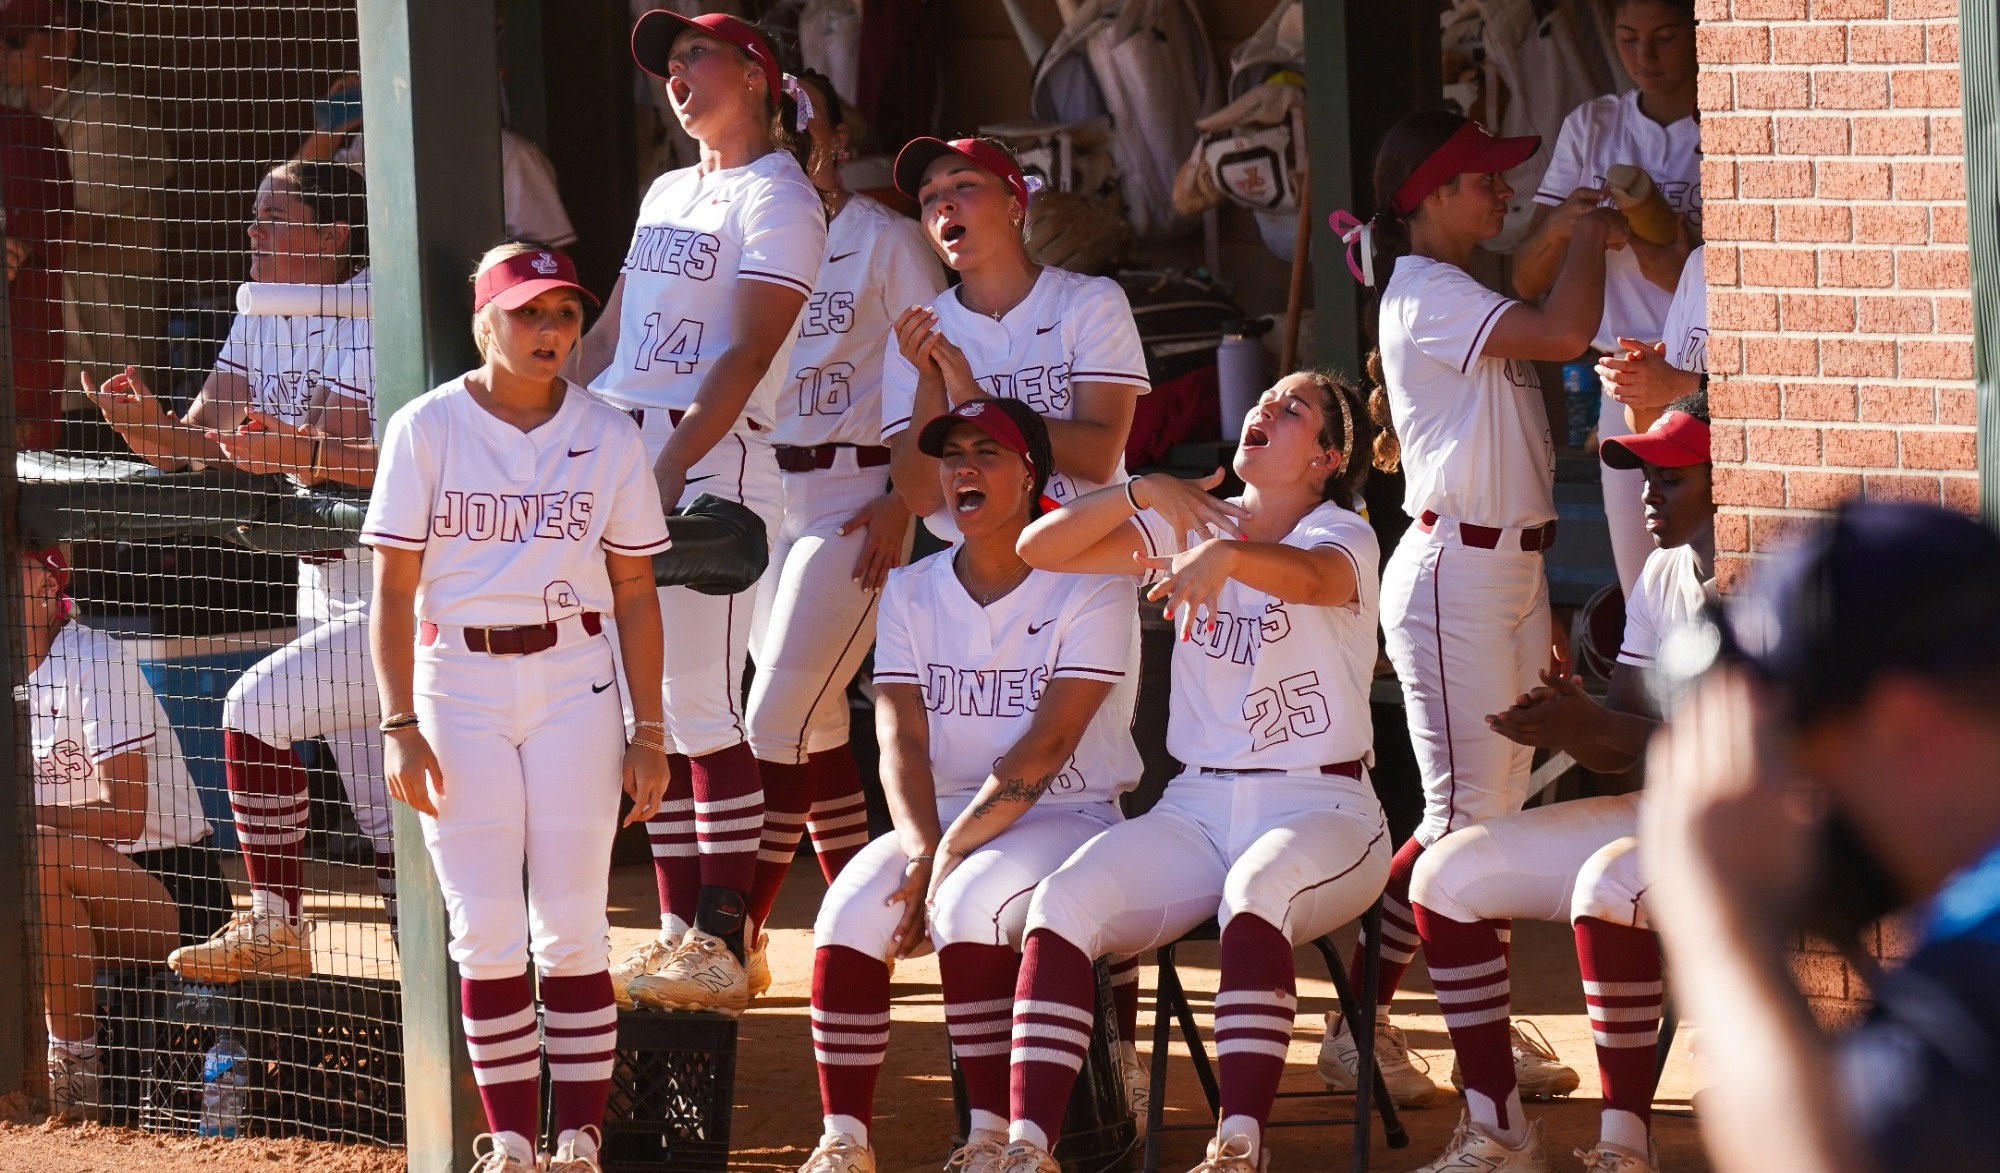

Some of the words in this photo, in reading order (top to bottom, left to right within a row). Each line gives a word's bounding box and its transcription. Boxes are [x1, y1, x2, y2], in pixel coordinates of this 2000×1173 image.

[624, 226, 721, 282] ONES
[634, 311, 704, 375] 14
[795, 360, 856, 417] 16
[433, 490, 595, 543] JONES
[1241, 670, 1332, 753] 25
